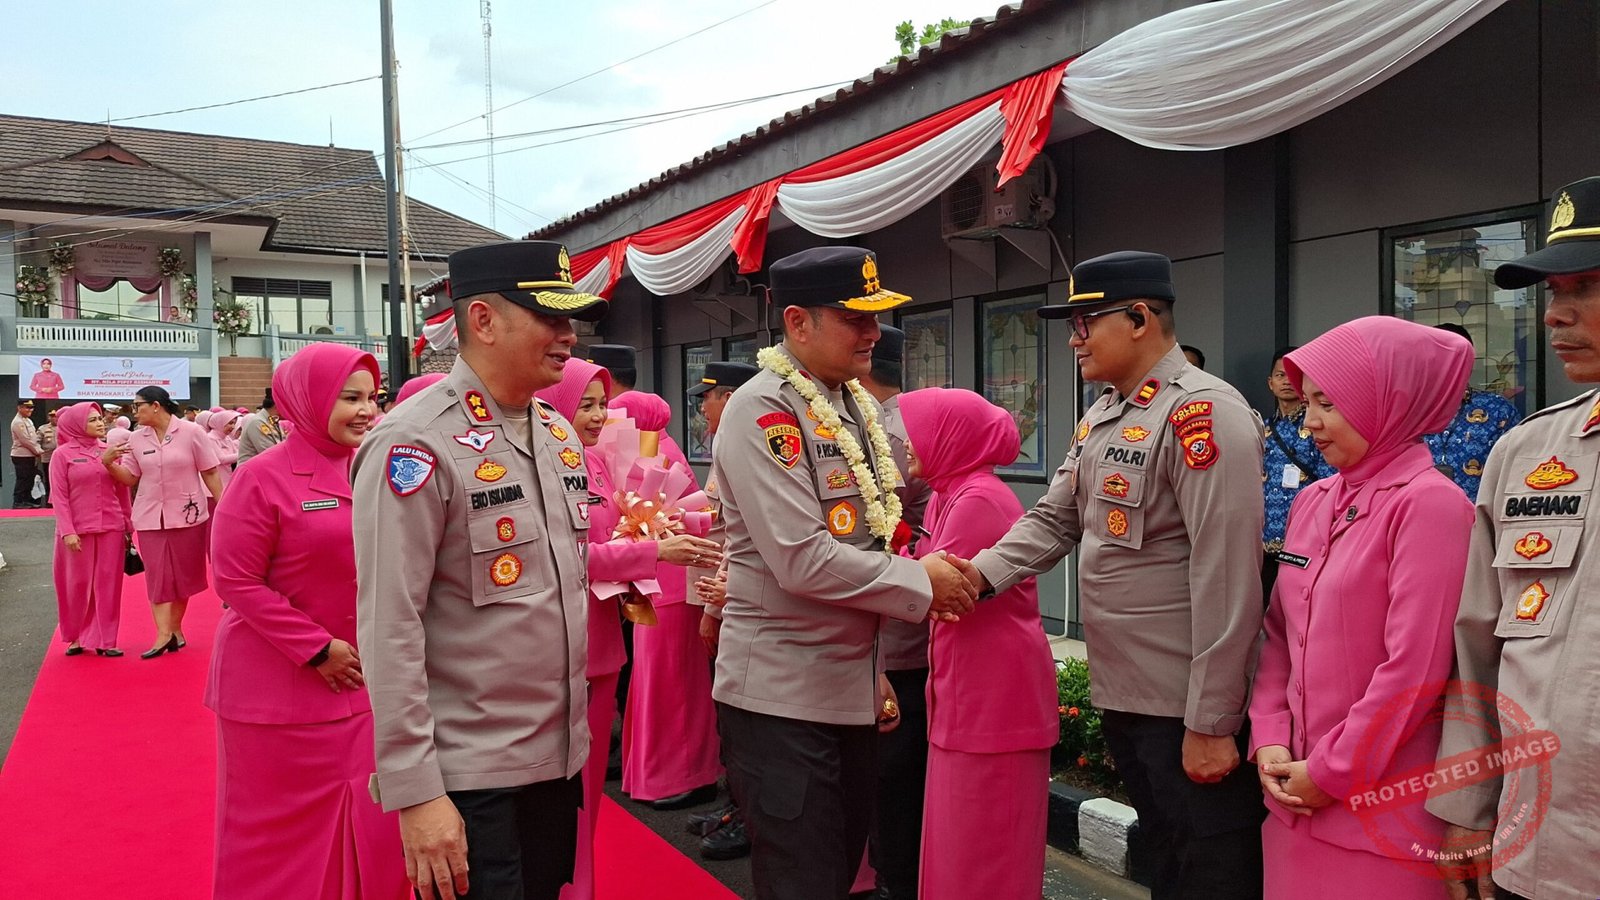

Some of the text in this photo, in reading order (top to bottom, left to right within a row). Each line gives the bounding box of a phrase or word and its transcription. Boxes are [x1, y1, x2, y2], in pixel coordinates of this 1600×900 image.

[1172, 403, 1208, 421] POLRES
[412, 449, 434, 463] LINTAS
[1104, 447, 1147, 467] POLRI
[470, 492, 488, 510] EKO
[1505, 495, 1581, 517] BAEHAKI
